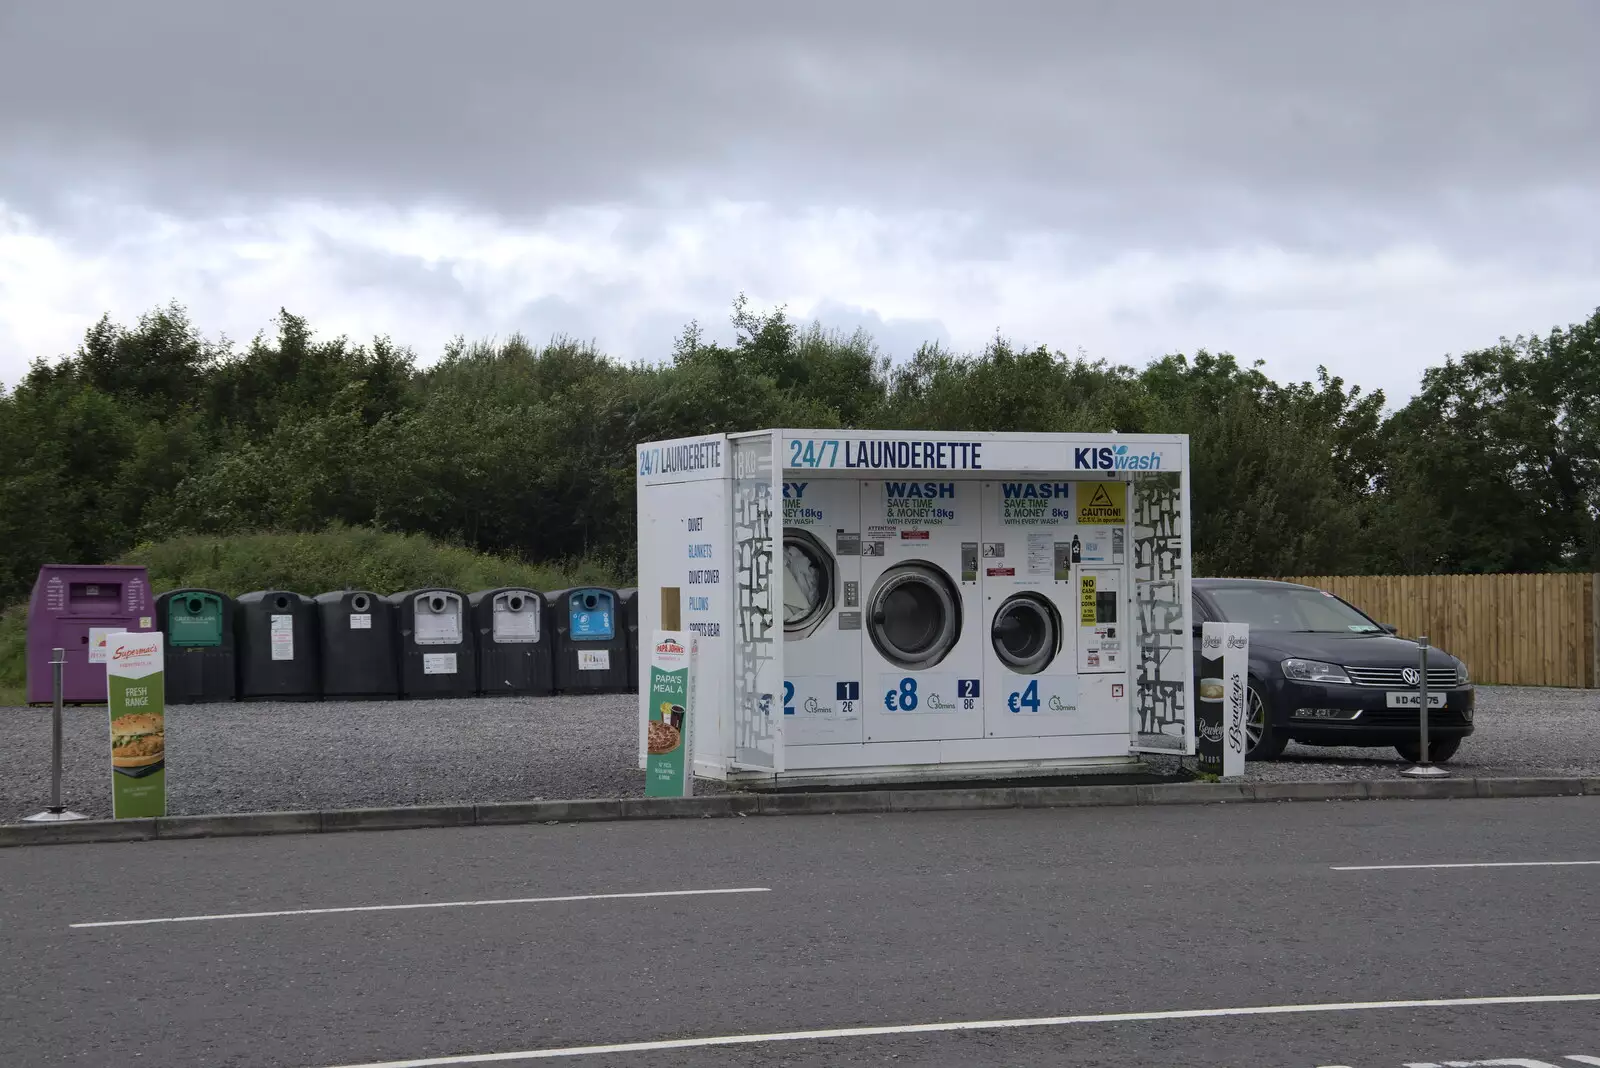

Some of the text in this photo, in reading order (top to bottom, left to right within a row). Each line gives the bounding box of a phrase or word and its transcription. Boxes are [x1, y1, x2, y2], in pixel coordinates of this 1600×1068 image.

[640, 441, 721, 476] 24/7 LAUNDERETTE
[790, 439, 982, 469] 24/7 LAUNDERETTE
[783, 483, 809, 498] RY
[884, 482, 955, 499] WASH
[1002, 483, 1069, 499] WASH
[887, 499, 933, 508] SAVE TIME
[1004, 499, 1049, 508] SAVE TIME
[799, 508, 823, 520] 18kg
[886, 508, 955, 520] & MONEY 18kg
[1004, 508, 1069, 519] & MONEY 8kg
[1081, 508, 1122, 517] CAUTION!
[688, 517, 703, 532] DUVET
[688, 544, 713, 559] BLANKETS
[688, 569, 720, 584] DUVET COVER
[1082, 580, 1095, 588] NO
[688, 596, 709, 611] PILLOWS
[1227, 634, 1247, 649] Bewley's
[112, 643, 158, 660] Supermac's
[655, 674, 682, 684] PAPA'S
[125, 687, 148, 697] FRESH
[653, 684, 684, 694] MEAL A
[884, 677, 918, 712] €8
[964, 680, 973, 697] 2
[125, 697, 149, 707] RANGE
[963, 698, 974, 710] 8€
[1007, 679, 1041, 714] €4
[1410, 696, 1439, 704] 4075
[842, 701, 853, 713] 2€
[1228, 673, 1244, 754] Bewley's
